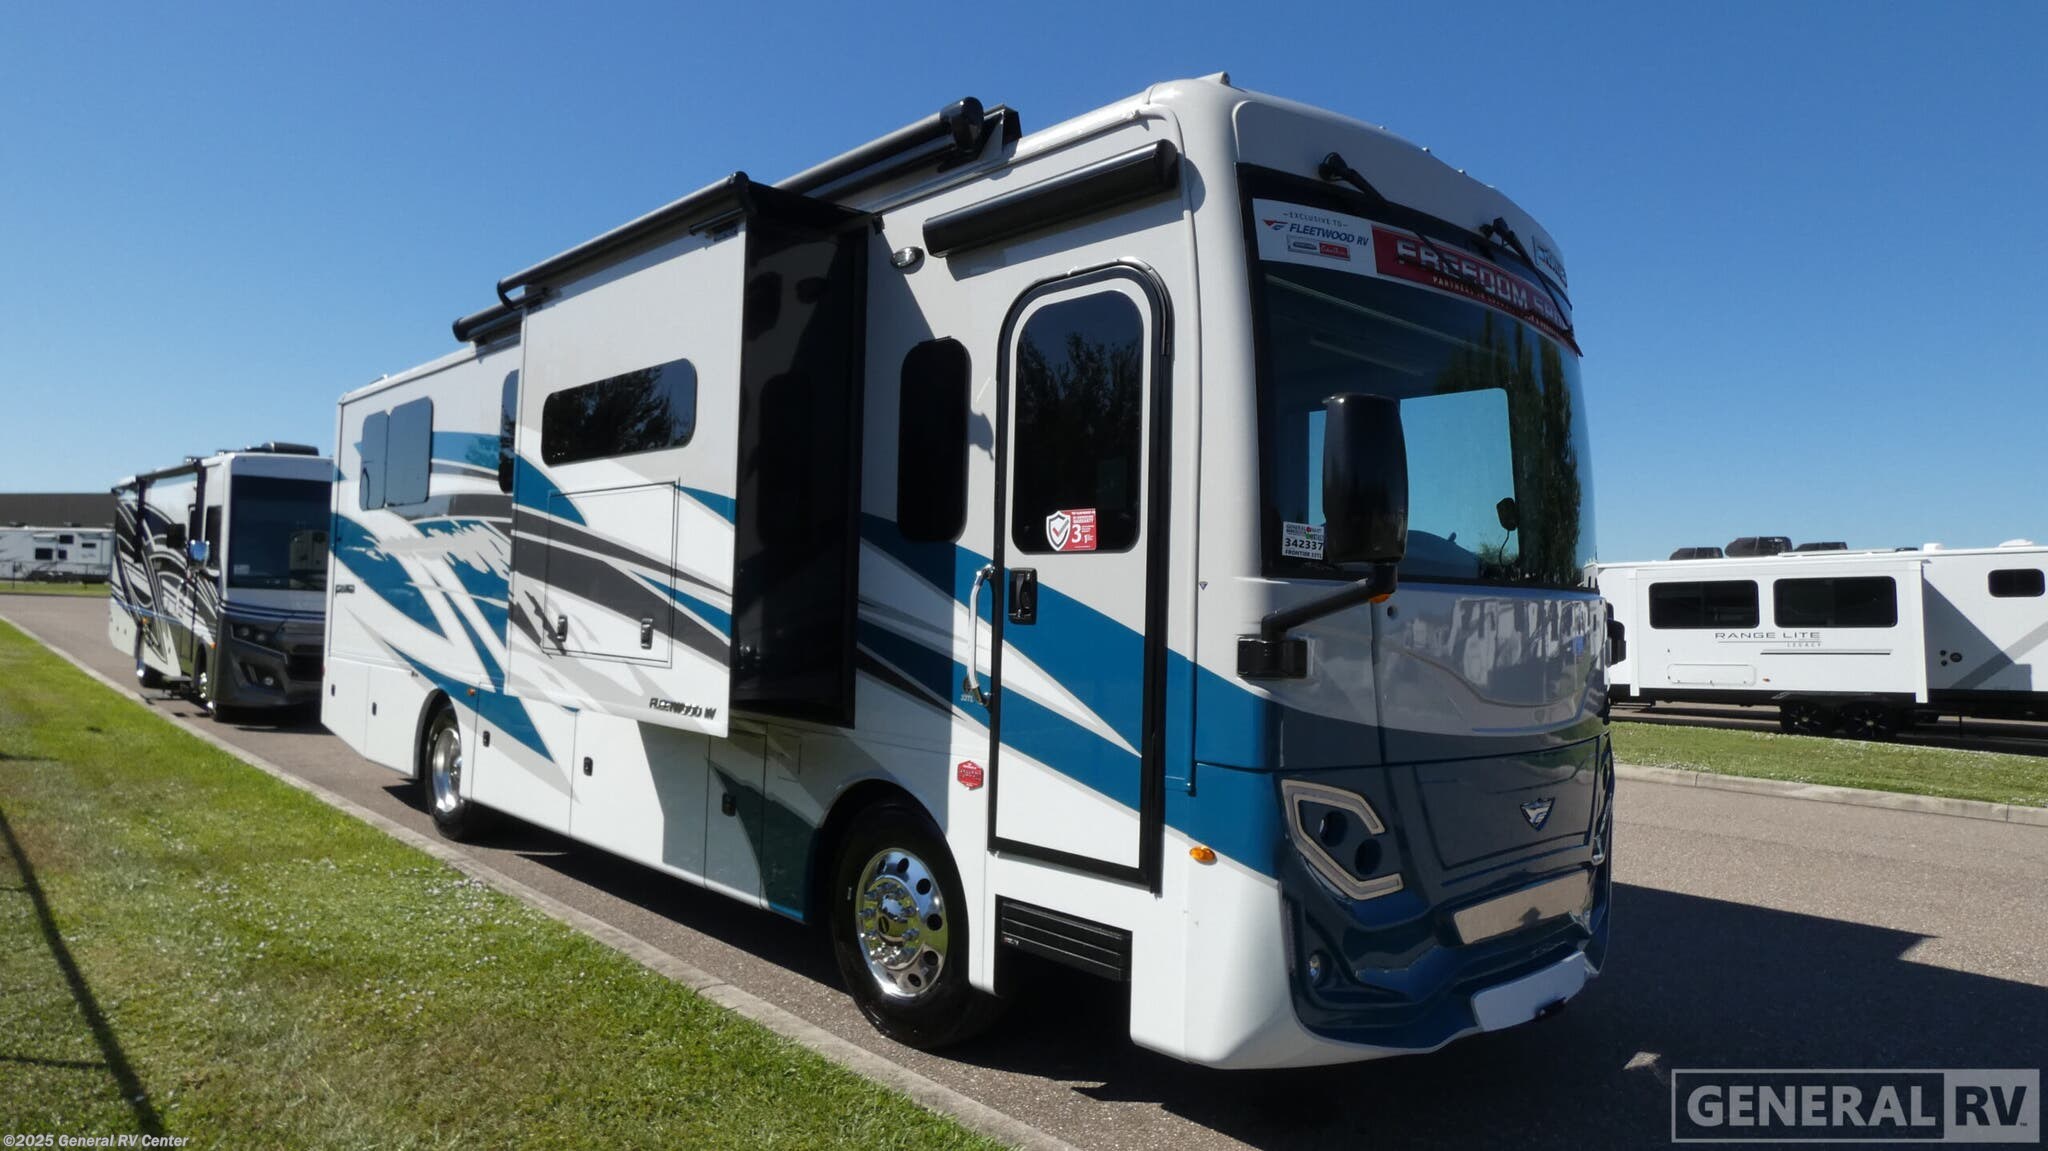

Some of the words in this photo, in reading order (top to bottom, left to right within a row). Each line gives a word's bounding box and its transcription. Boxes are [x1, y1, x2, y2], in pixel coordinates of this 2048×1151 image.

[1290, 211, 1331, 226] EXCLUSIVE
[1289, 223, 1355, 243] FLEETWOOD
[1356, 235, 1370, 246] RV
[1396, 239, 1528, 310] FREEDOM
[1072, 524, 1082, 543] 3
[1285, 537, 1323, 551] 342337
